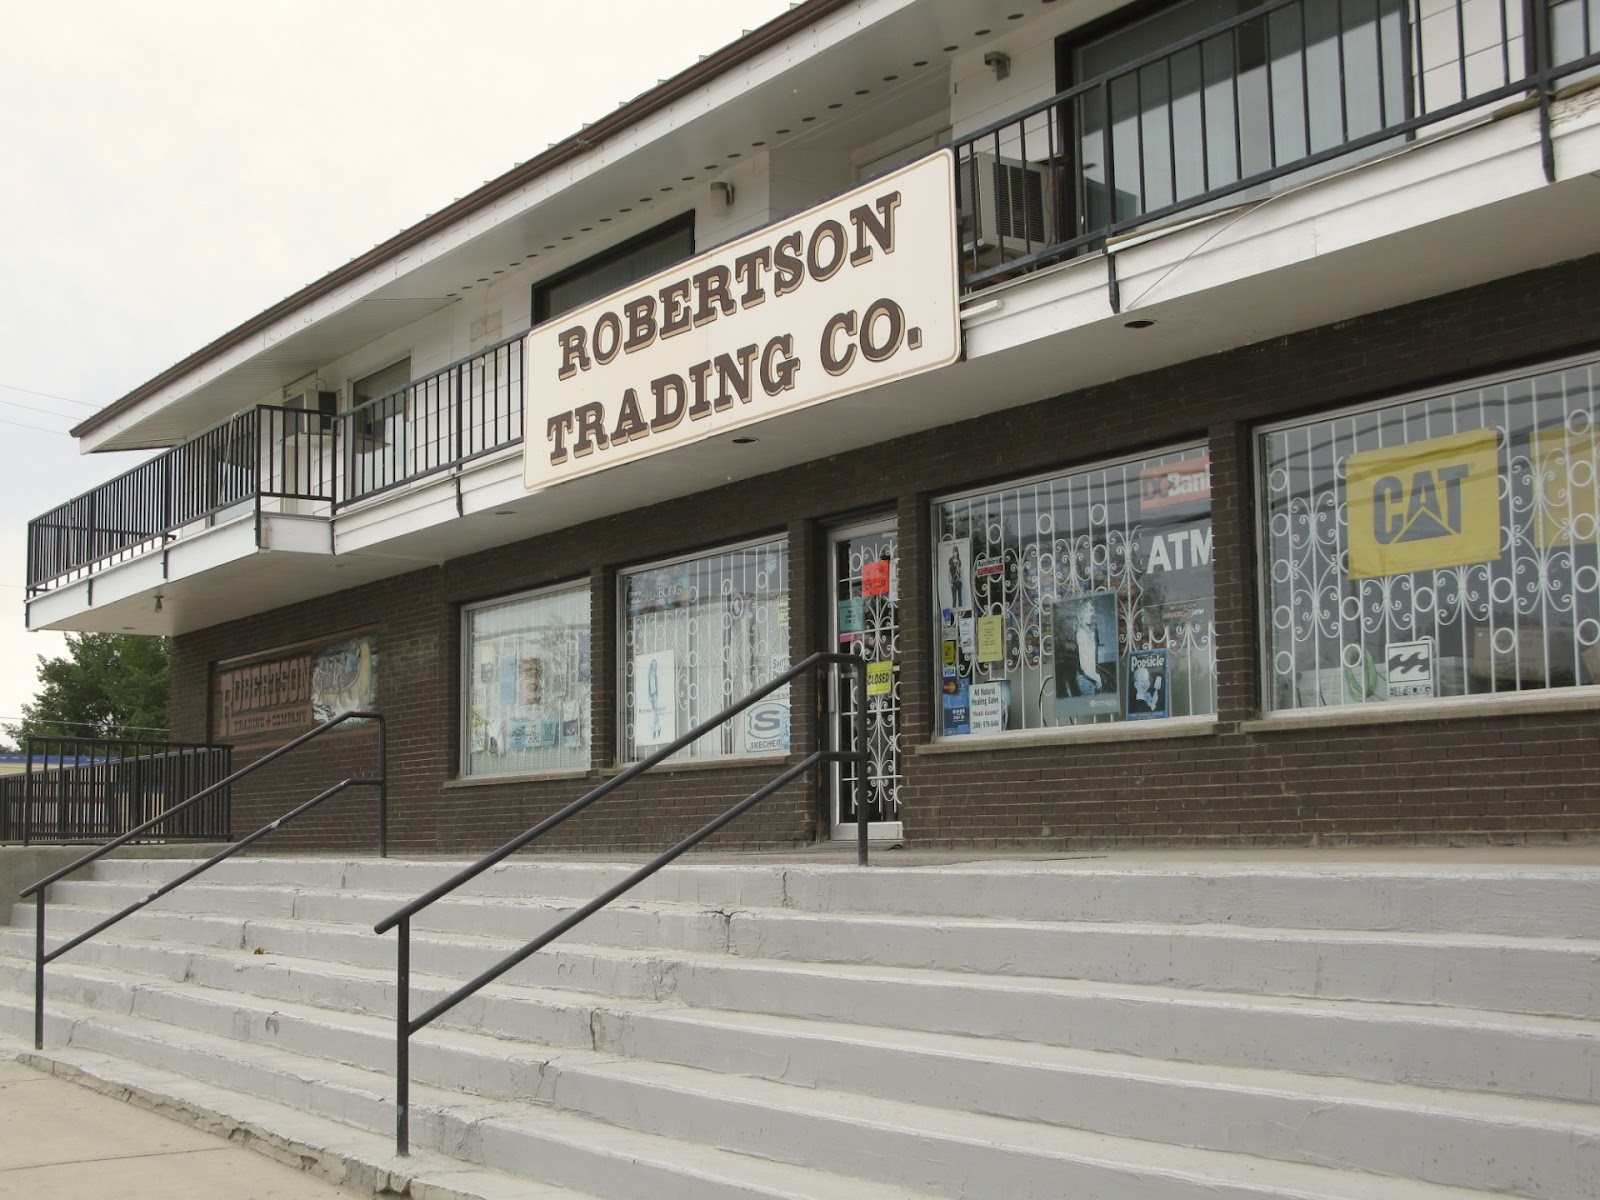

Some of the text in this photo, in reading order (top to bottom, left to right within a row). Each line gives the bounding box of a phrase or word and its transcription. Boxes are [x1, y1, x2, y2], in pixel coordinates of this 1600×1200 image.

[557, 190, 901, 381] ROBERTSON
[547, 298, 922, 466] TRADING CO.
[1372, 463, 1471, 545] CAT
[1146, 526, 1213, 574] ATM
[867, 672, 890, 685] CLOSED
[1131, 654, 1165, 672] Popsicle
[220, 655, 312, 738] ROBERTSON
[980, 687, 996, 696] Natural
[234, 709, 307, 732] TRADING COMPANY
[750, 738, 784, 749] SKECHER
